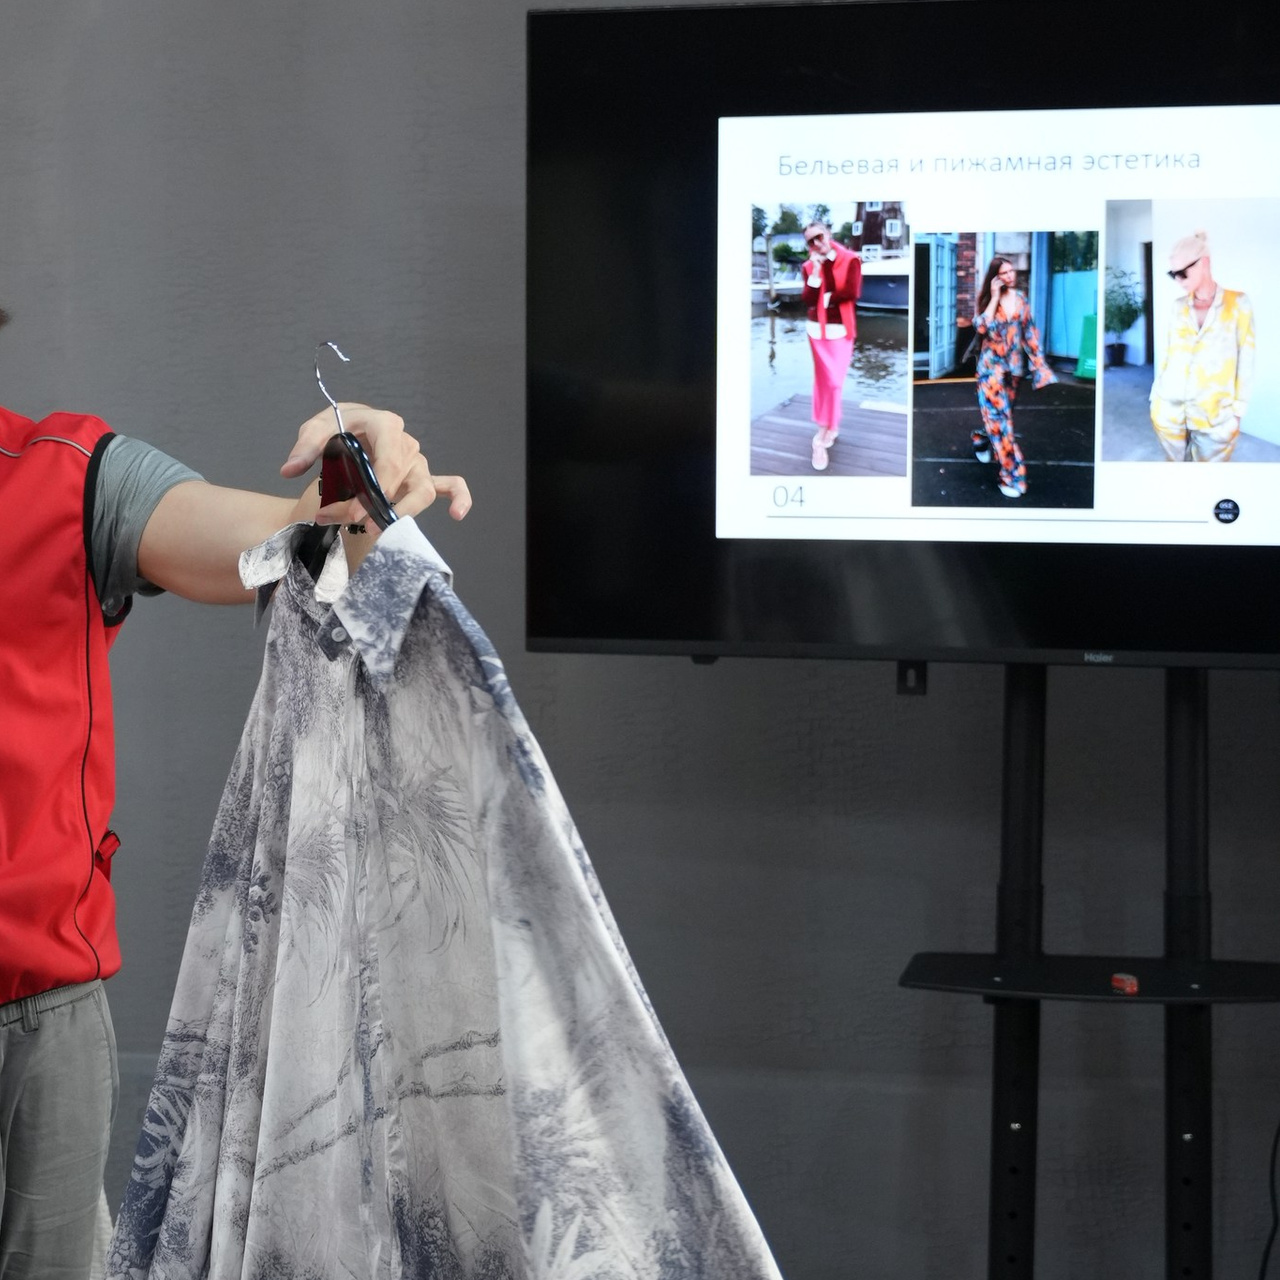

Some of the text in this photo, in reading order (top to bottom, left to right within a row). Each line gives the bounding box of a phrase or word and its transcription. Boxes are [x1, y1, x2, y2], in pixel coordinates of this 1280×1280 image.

[778, 153, 1201, 176] Бельевая и пижамная эстетика
[772, 485, 806, 508] 04
[1083, 651, 1113, 662] Haier
